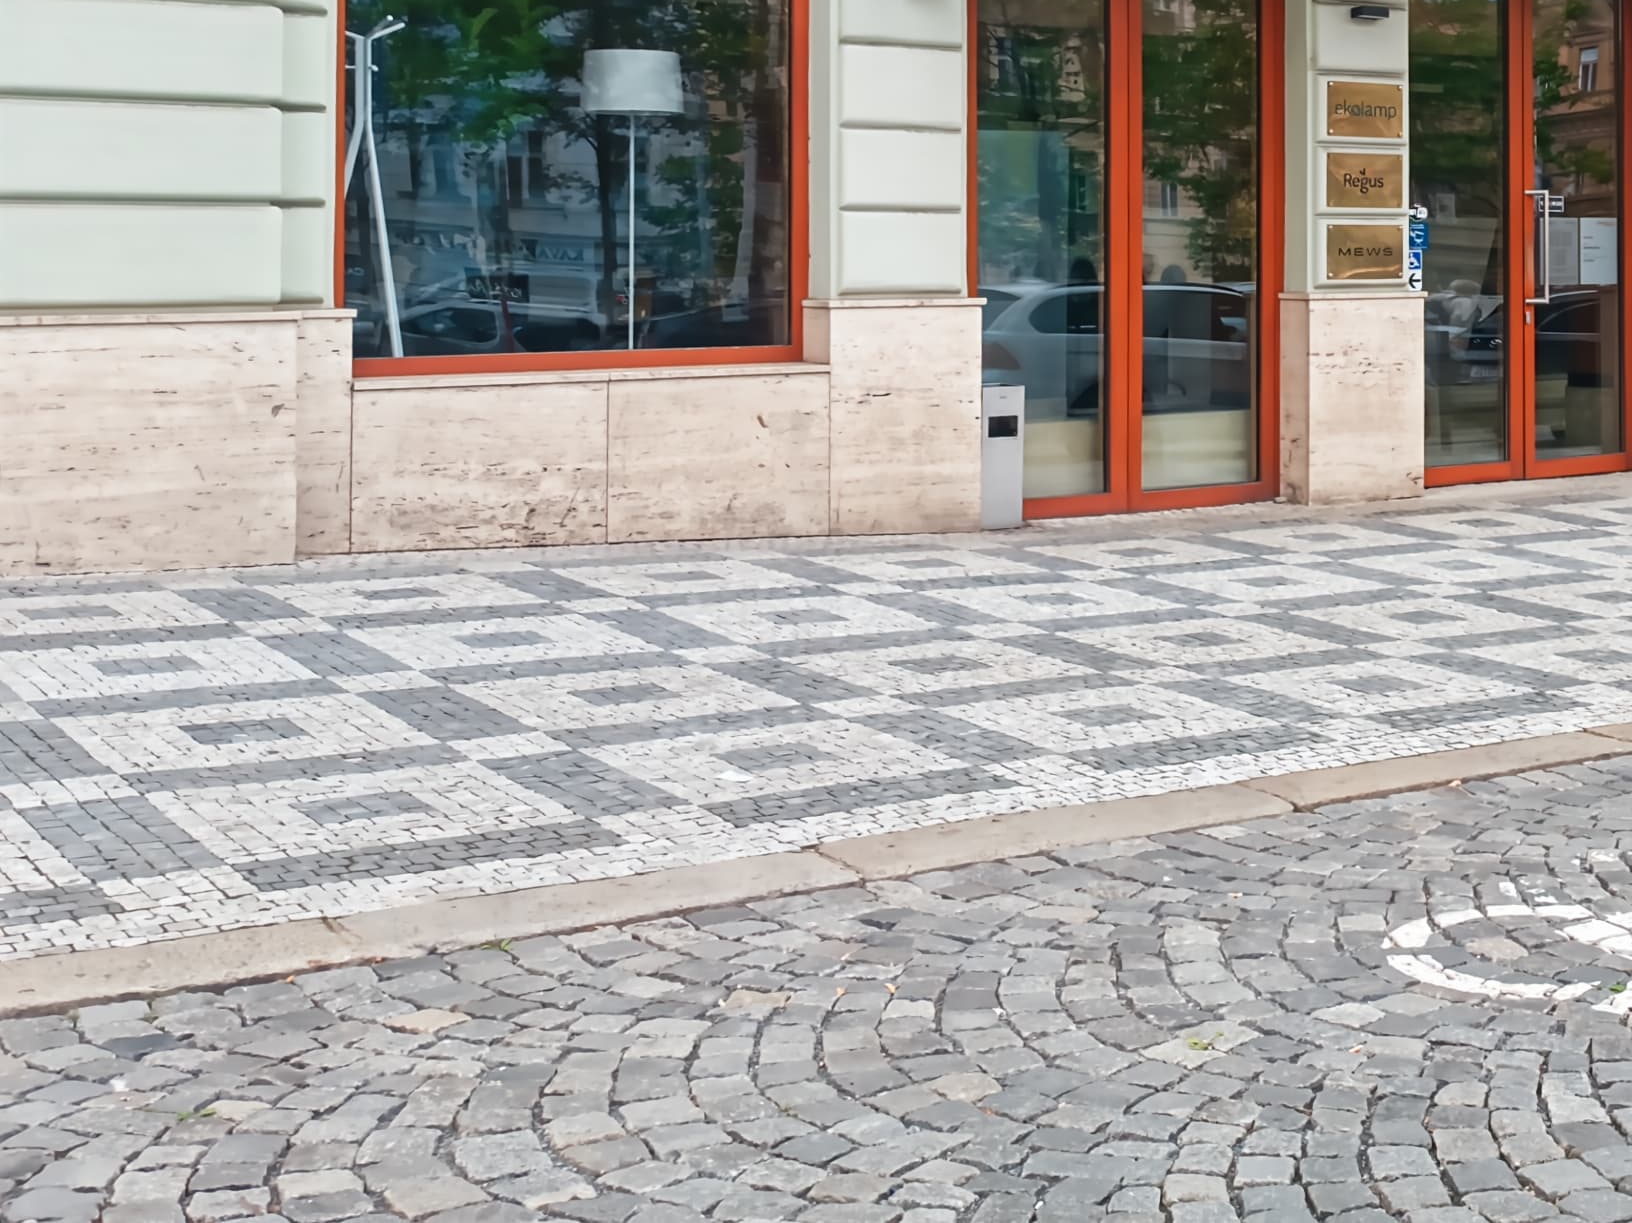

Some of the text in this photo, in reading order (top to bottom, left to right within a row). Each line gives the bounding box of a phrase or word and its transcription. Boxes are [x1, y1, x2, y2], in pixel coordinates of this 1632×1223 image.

[1334, 99, 1398, 121] ekolamp
[1343, 170, 1385, 194] Regus
[1338, 246, 1393, 257] MEWS
